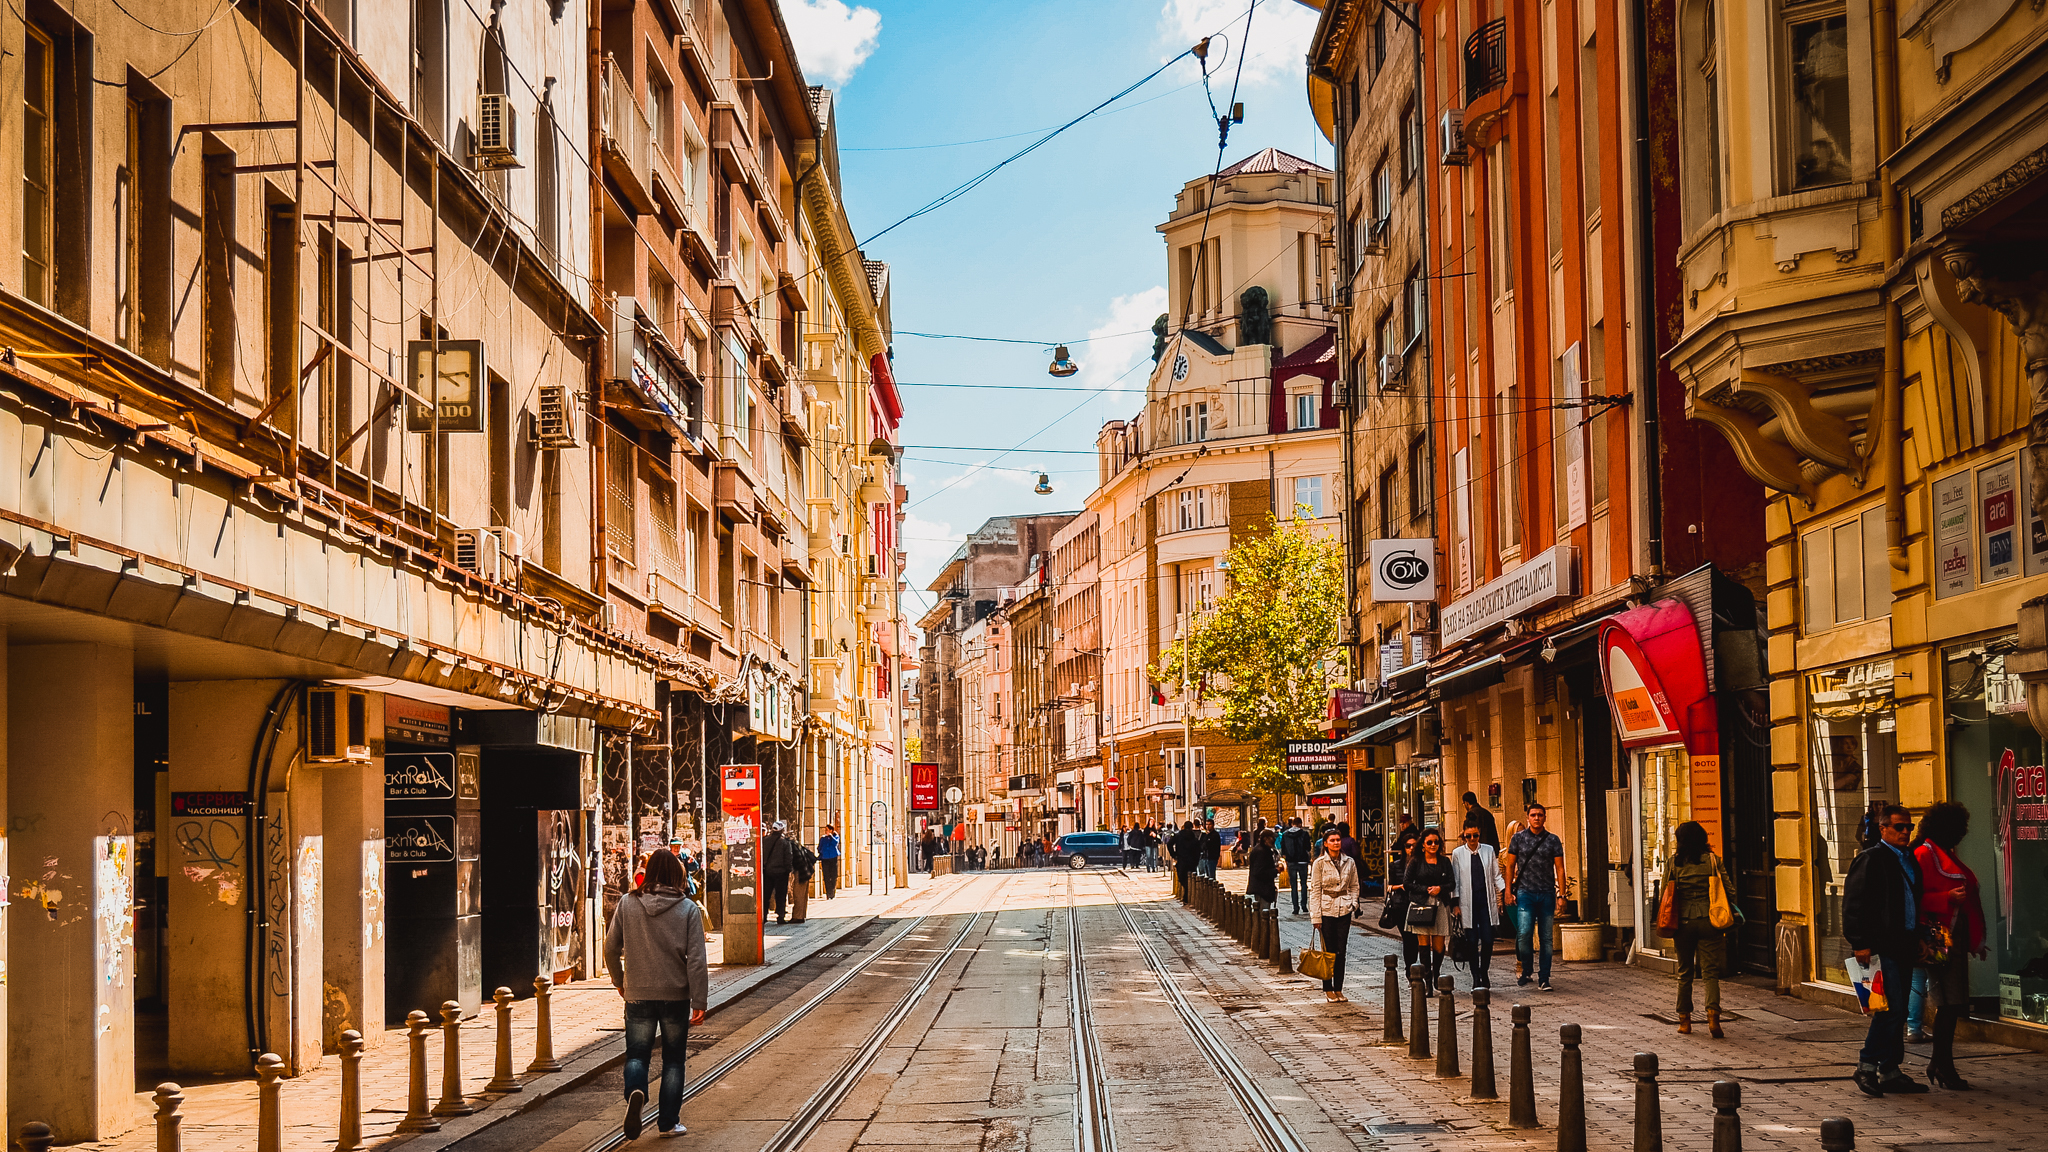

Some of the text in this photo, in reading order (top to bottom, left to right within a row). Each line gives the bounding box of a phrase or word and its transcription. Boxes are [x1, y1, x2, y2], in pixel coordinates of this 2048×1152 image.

[416, 405, 471, 418] RADO
[1989, 501, 2006, 521] ara
[1457, 609, 1466, 631] НА
[1505, 561, 1552, 607] ЖУРНАЛИСТИ
[1289, 755, 1336, 763] ЛЕГАЛИЗАЦИЯ
[2015, 765, 2047, 798] ara
[187, 793, 244, 806] СЕРВИЗ
[187, 807, 244, 815] ЧАСОВНИЦИ
[1361, 808, 1383, 822] NO
[410, 849, 427, 857] Club
